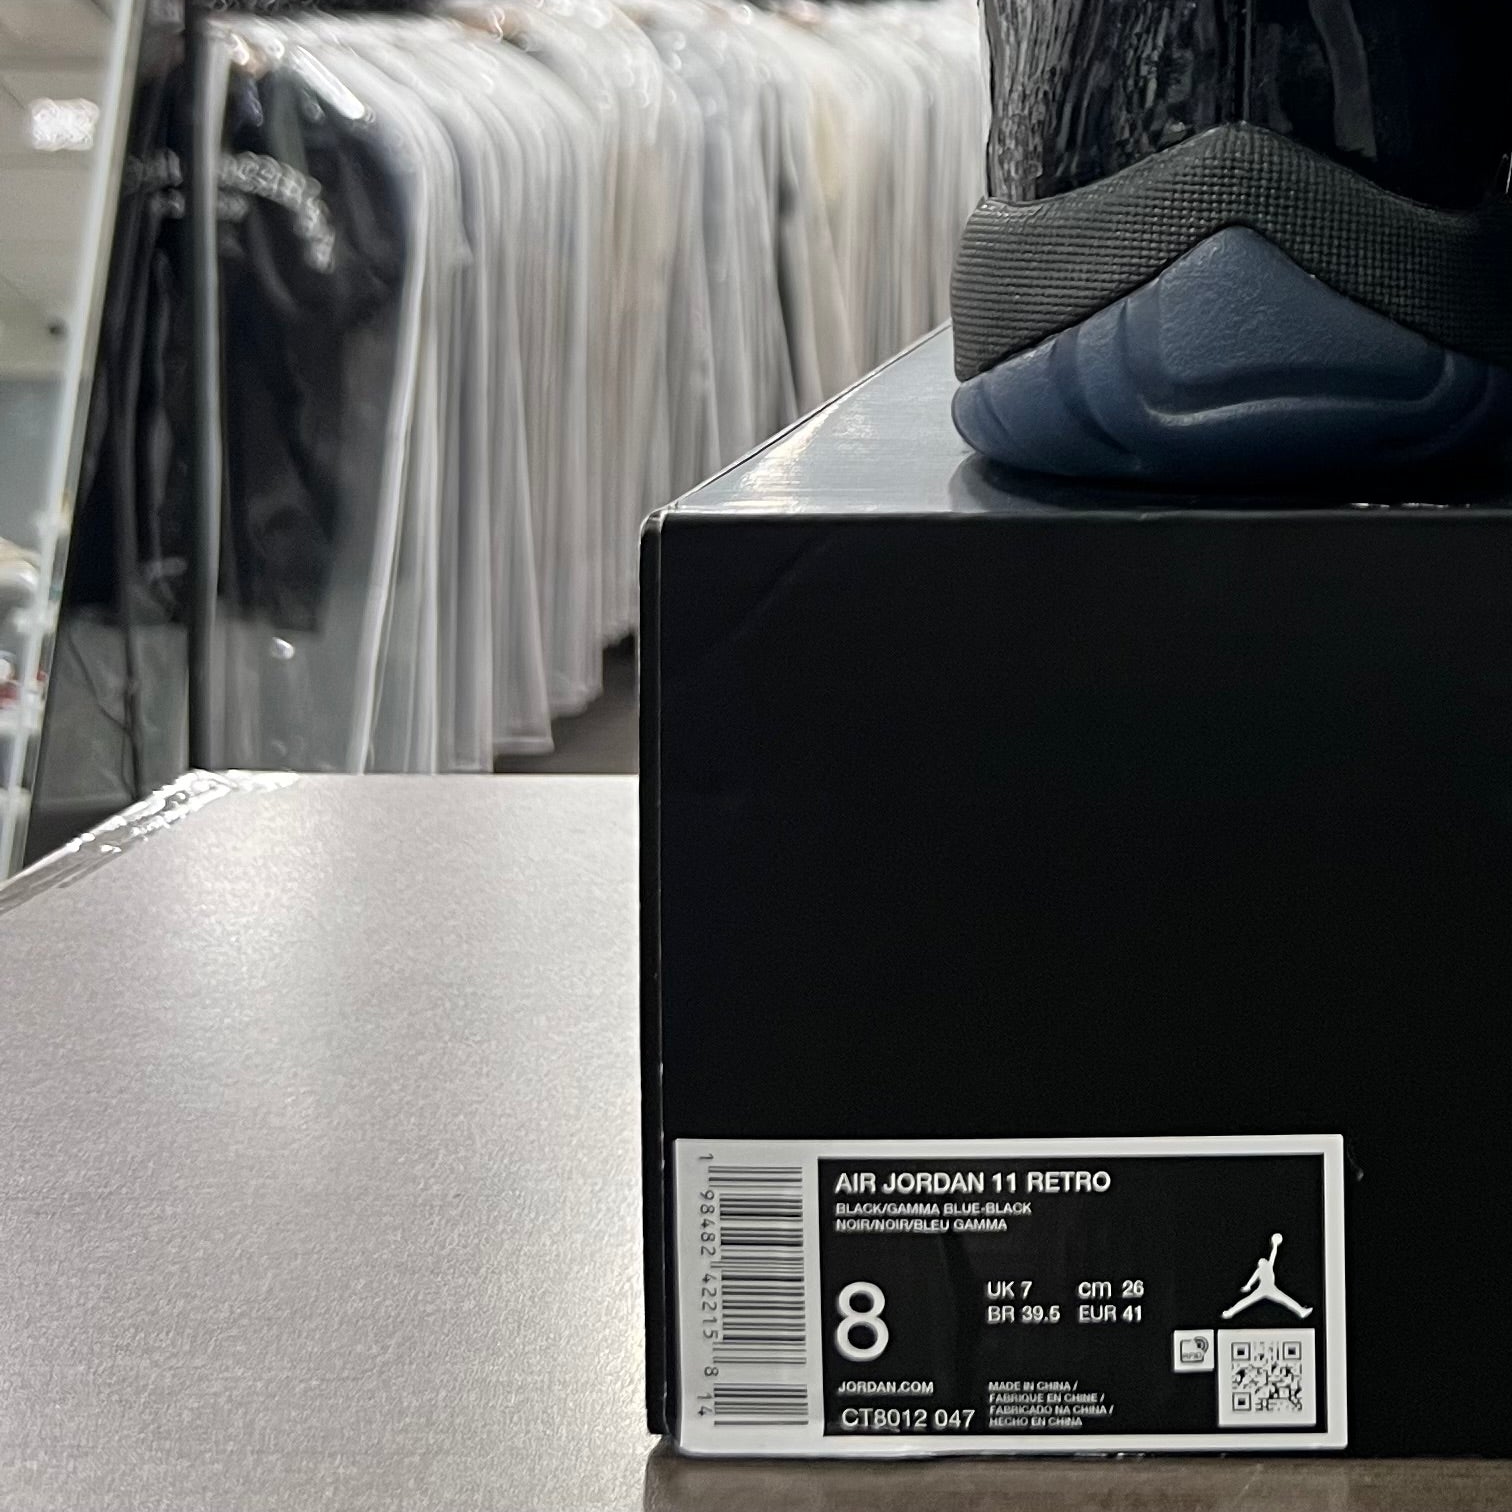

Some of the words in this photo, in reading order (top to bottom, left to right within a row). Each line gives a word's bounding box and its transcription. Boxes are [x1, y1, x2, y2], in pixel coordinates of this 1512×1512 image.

[699, 1152, 714, 1161] 1
[835, 1173, 875, 1193] AIR
[883, 1172, 984, 1193] JORDAN
[993, 1173, 1015, 1192] 11
[1028, 1171, 1110, 1192] RETRO
[836, 1203, 940, 1215] BLACK/GAMMA
[944, 1202, 1031, 1215] BLUE-BLACK
[700, 1189, 716, 1255] 98482
[836, 1219, 949, 1232] NOIR/NOIR/BLEU
[954, 1219, 1007, 1230] GAMMA
[988, 1281, 1014, 1298] UK
[1022, 1281, 1032, 1298] 7
[1079, 1282, 1111, 1298] cm
[1123, 1280, 1144, 1297] 26
[702, 1272, 718, 1339] 42215
[1079, 1305, 1116, 1322] EUR
[1123, 1306, 1141, 1321] 41
[836, 1282, 888, 1361] 8
[988, 1306, 1014, 1322] BR
[1022, 1306, 1060, 1322] 39.5
[704, 1367, 718, 1376] 8
[838, 1381, 933, 1394] JORDAN.COM
[989, 1382, 1020, 1392] MADE
[1023, 1382, 1034, 1391] IN
[1037, 1382, 1071, 1391] CHINA
[697, 1392, 713, 1417] 14
[989, 1393, 1043, 1403] FABRIQUE
[1047, 1394, 1061, 1403] EN
[1064, 1393, 1097, 1403] CHINE
[842, 1408, 927, 1428] CT8012
[935, 1409, 975, 1428] 047
[990, 1405, 1052, 1415] FABRICADO
[1055, 1406, 1070, 1415] NA
[1073, 1405, 1107, 1415] CHINA
[989, 1417, 1028, 1427] HECHO
[1031, 1417, 1045, 1426] EN
[1048, 1417, 1082, 1427] CHINA
